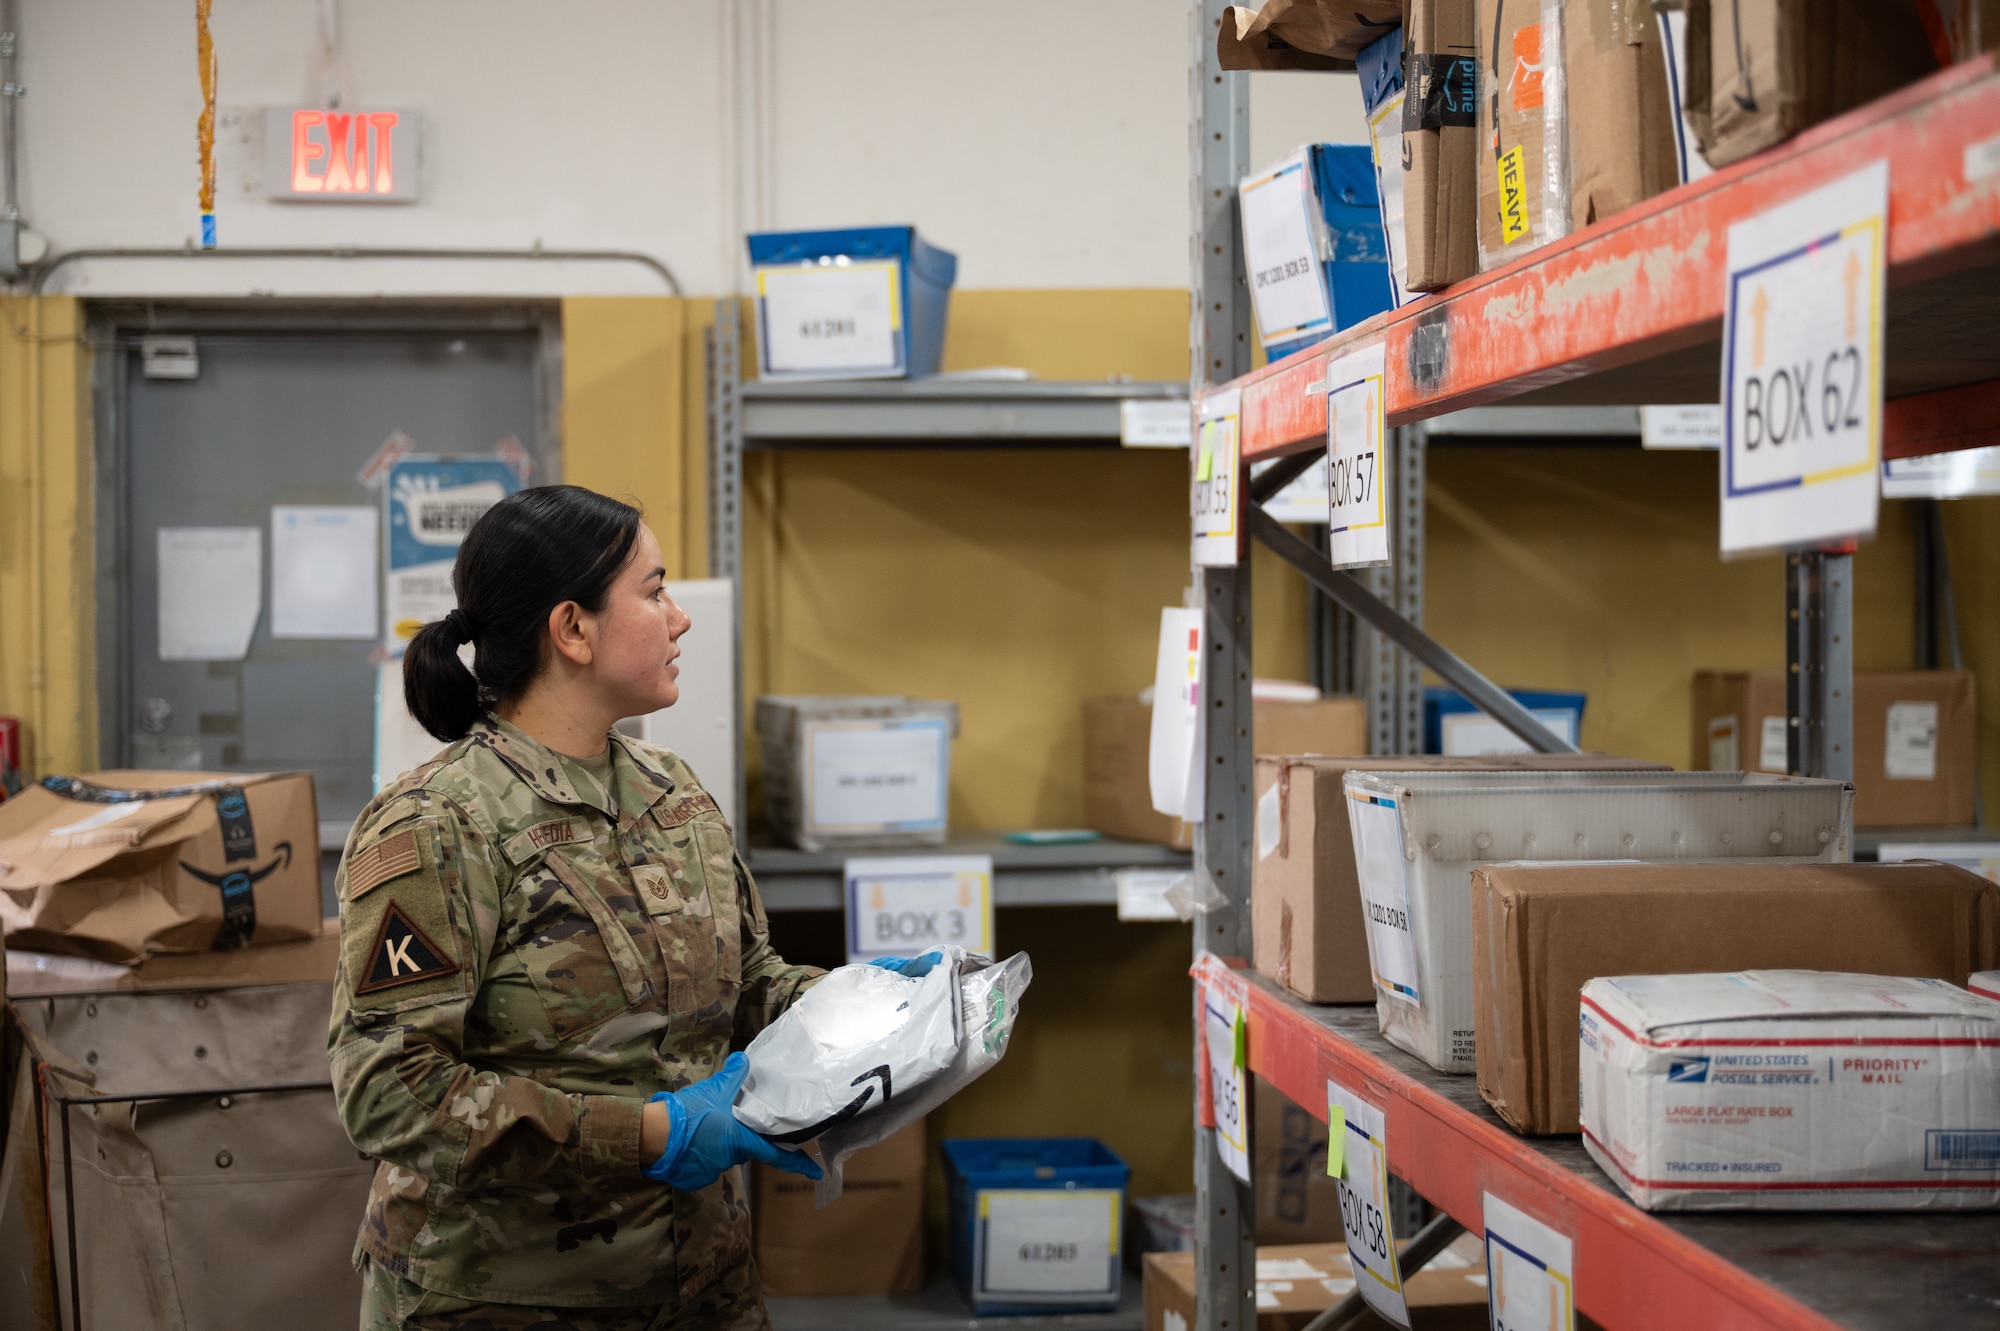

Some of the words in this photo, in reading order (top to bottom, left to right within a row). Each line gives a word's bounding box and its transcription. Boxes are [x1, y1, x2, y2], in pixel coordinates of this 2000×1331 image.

[1458, 60, 1476, 113] prime
[291, 109, 399, 194] EXIT
[1503, 151, 1522, 232] HEAVY
[1745, 360, 1814, 453] BOX
[1822, 344, 1863, 435] 62
[1214, 473, 1228, 515] 53
[1331, 456, 1353, 508] BOX
[1355, 451, 1374, 504] 57
[875, 910, 941, 942] BOX
[947, 909, 967, 942] 3
[1386, 906, 1401, 929] BOX
[385, 934, 422, 977] K
[1711, 1073, 1758, 1084] POSTAL
[1760, 1074, 1812, 1085] SERVICE
[1714, 1055, 1763, 1066] UNITED
[1761, 1055, 1809, 1066] STATES
[1842, 1059, 1922, 1071] PRIORITY
[1862, 1074, 1903, 1084] MAIL
[1224, 1079, 1238, 1125] 56
[1665, 1106, 1704, 1116] LARGE
[1707, 1106, 1734, 1117] FLAT
[1737, 1106, 1765, 1117] RATE
[1768, 1107, 1793, 1117] BOX
[1666, 1162, 1719, 1172] TRACKED
[1730, 1163, 1782, 1173] INSURED
[1340, 1182, 1367, 1246] BOX
[1366, 1203, 1387, 1260] 58
